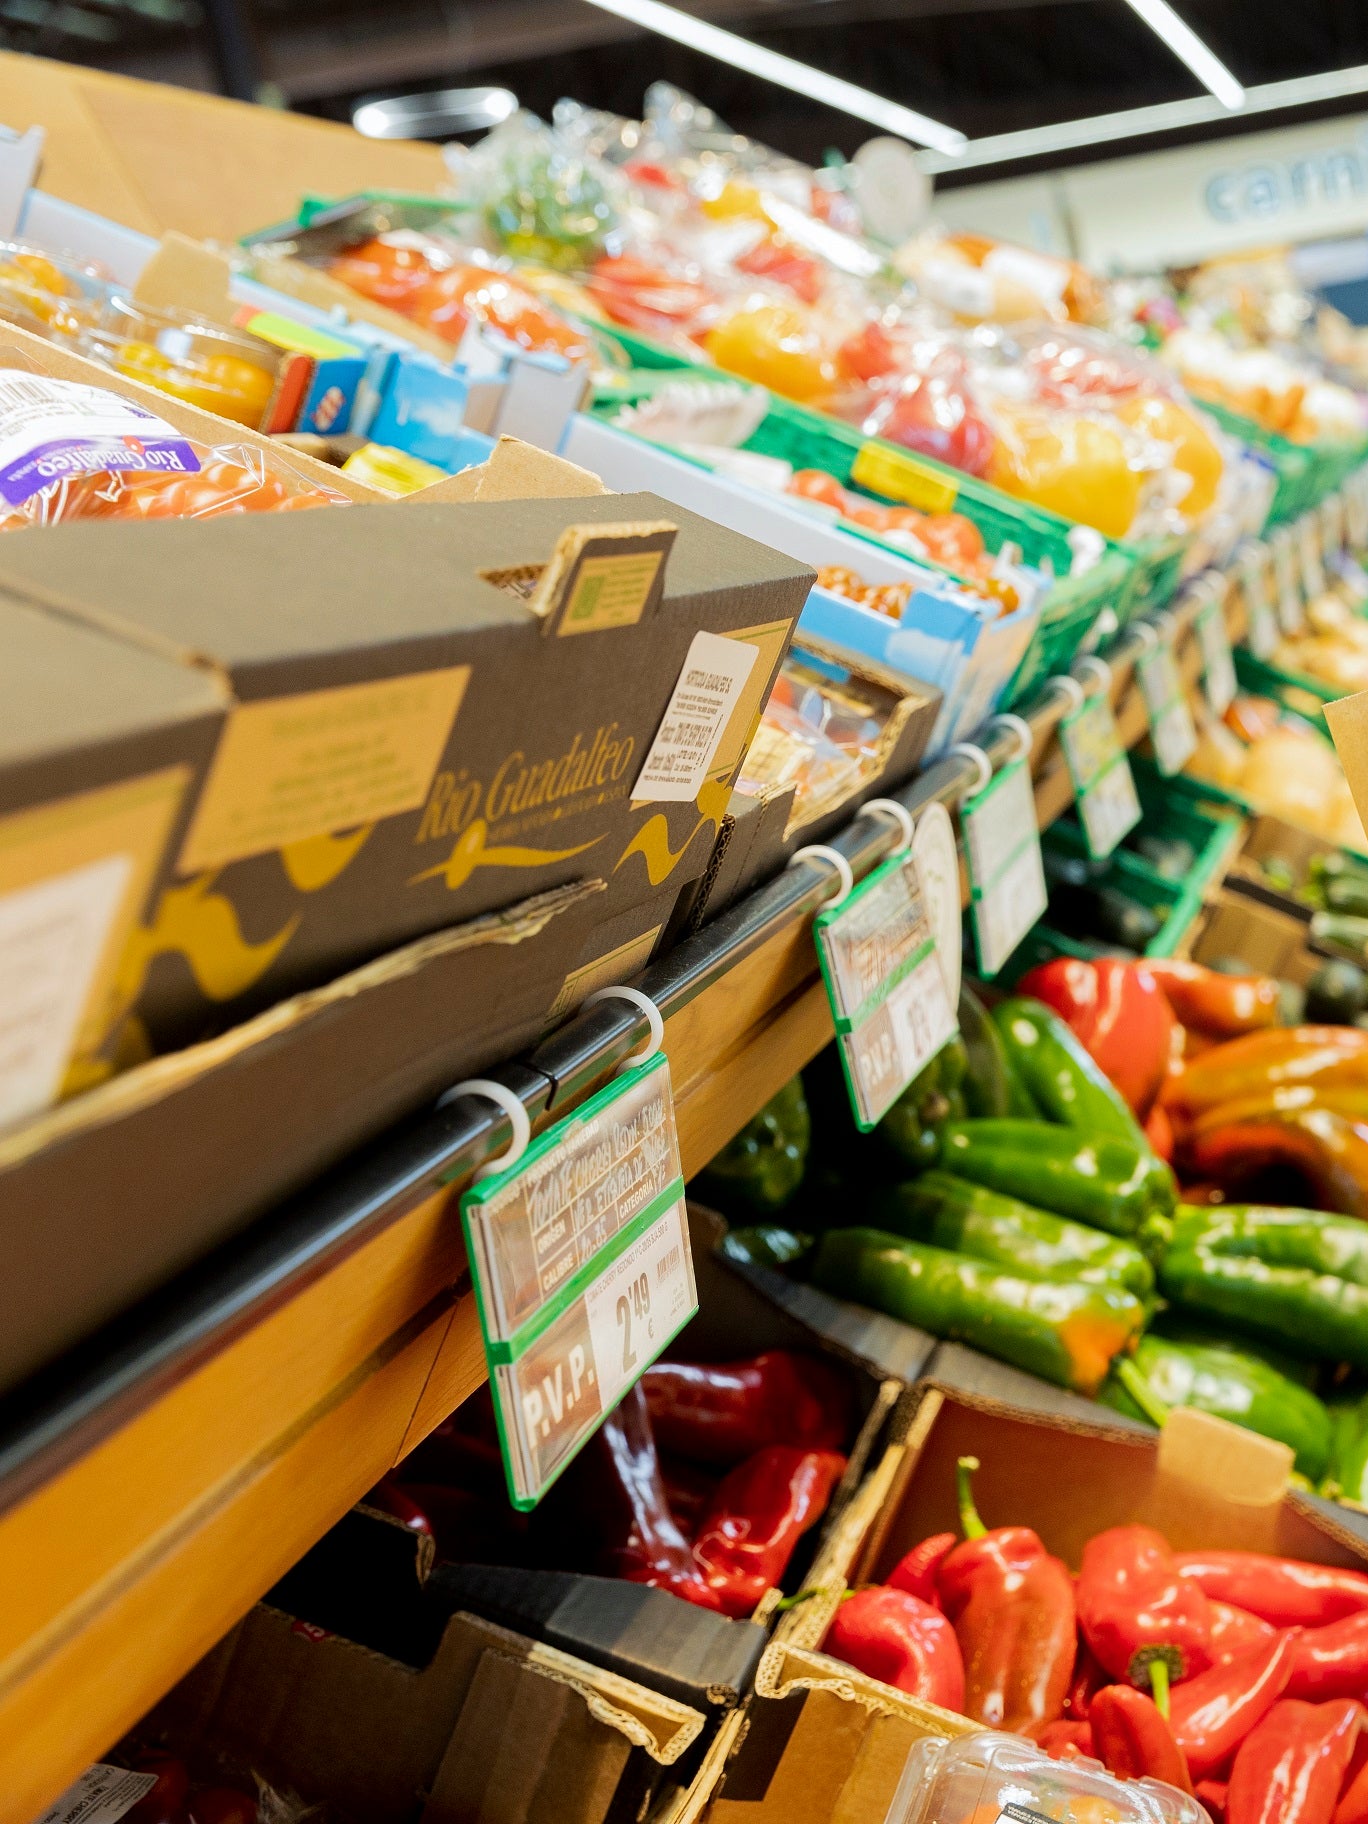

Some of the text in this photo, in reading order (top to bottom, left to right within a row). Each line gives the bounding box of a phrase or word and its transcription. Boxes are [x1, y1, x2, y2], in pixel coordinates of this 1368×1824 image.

[37, 448, 147, 477] Guadalfeo
[485, 721, 635, 824] Guadalfeo
[543, 1252, 574, 1291] CALIBRE
[616, 1272, 650, 1374] 2'49
[522, 1343, 596, 1452] P.V.P.
